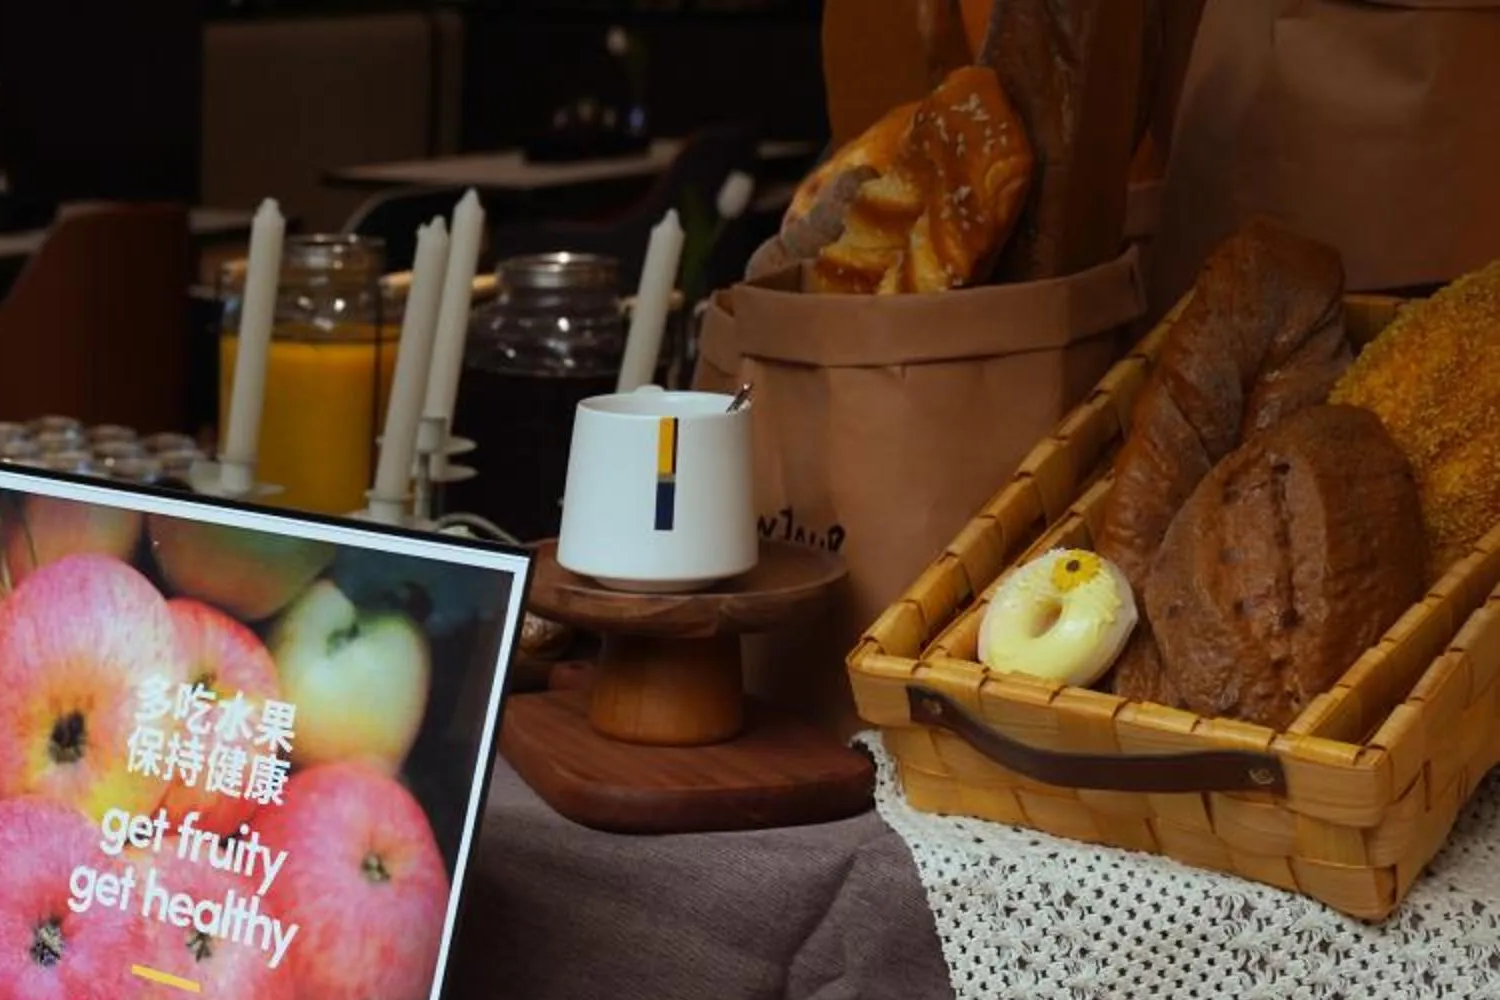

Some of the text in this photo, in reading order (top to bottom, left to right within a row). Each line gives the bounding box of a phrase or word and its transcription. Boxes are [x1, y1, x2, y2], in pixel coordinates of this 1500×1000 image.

[135, 674, 297, 753] 多吃水果
[127, 725, 292, 806] 保持健康
[100, 807, 289, 896] get fruity
[67, 865, 300, 969] get healthy
